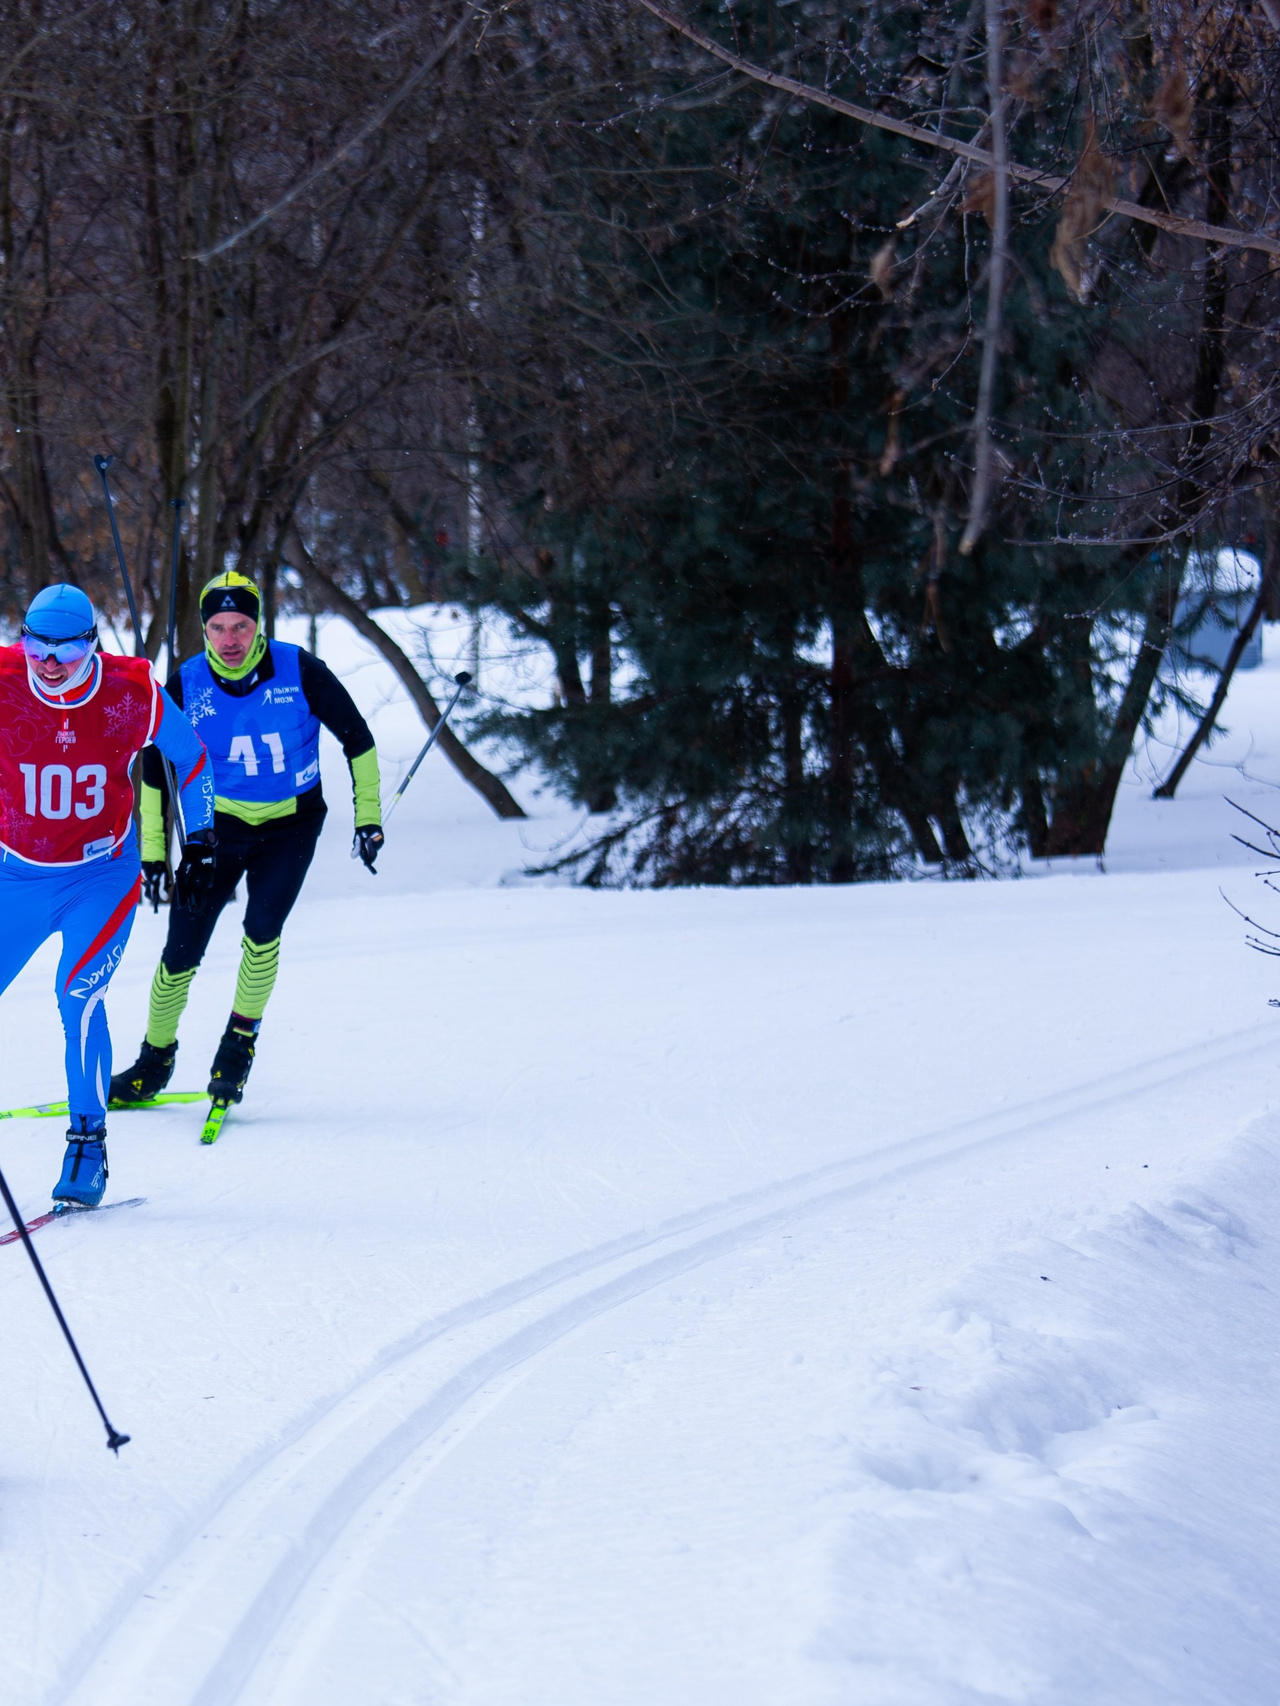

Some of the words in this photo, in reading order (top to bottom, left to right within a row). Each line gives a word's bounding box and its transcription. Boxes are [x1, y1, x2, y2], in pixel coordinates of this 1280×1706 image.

[227, 732, 286, 776] 41
[19, 763, 107, 820] 103
[66, 1133, 98, 1141] SPINE
